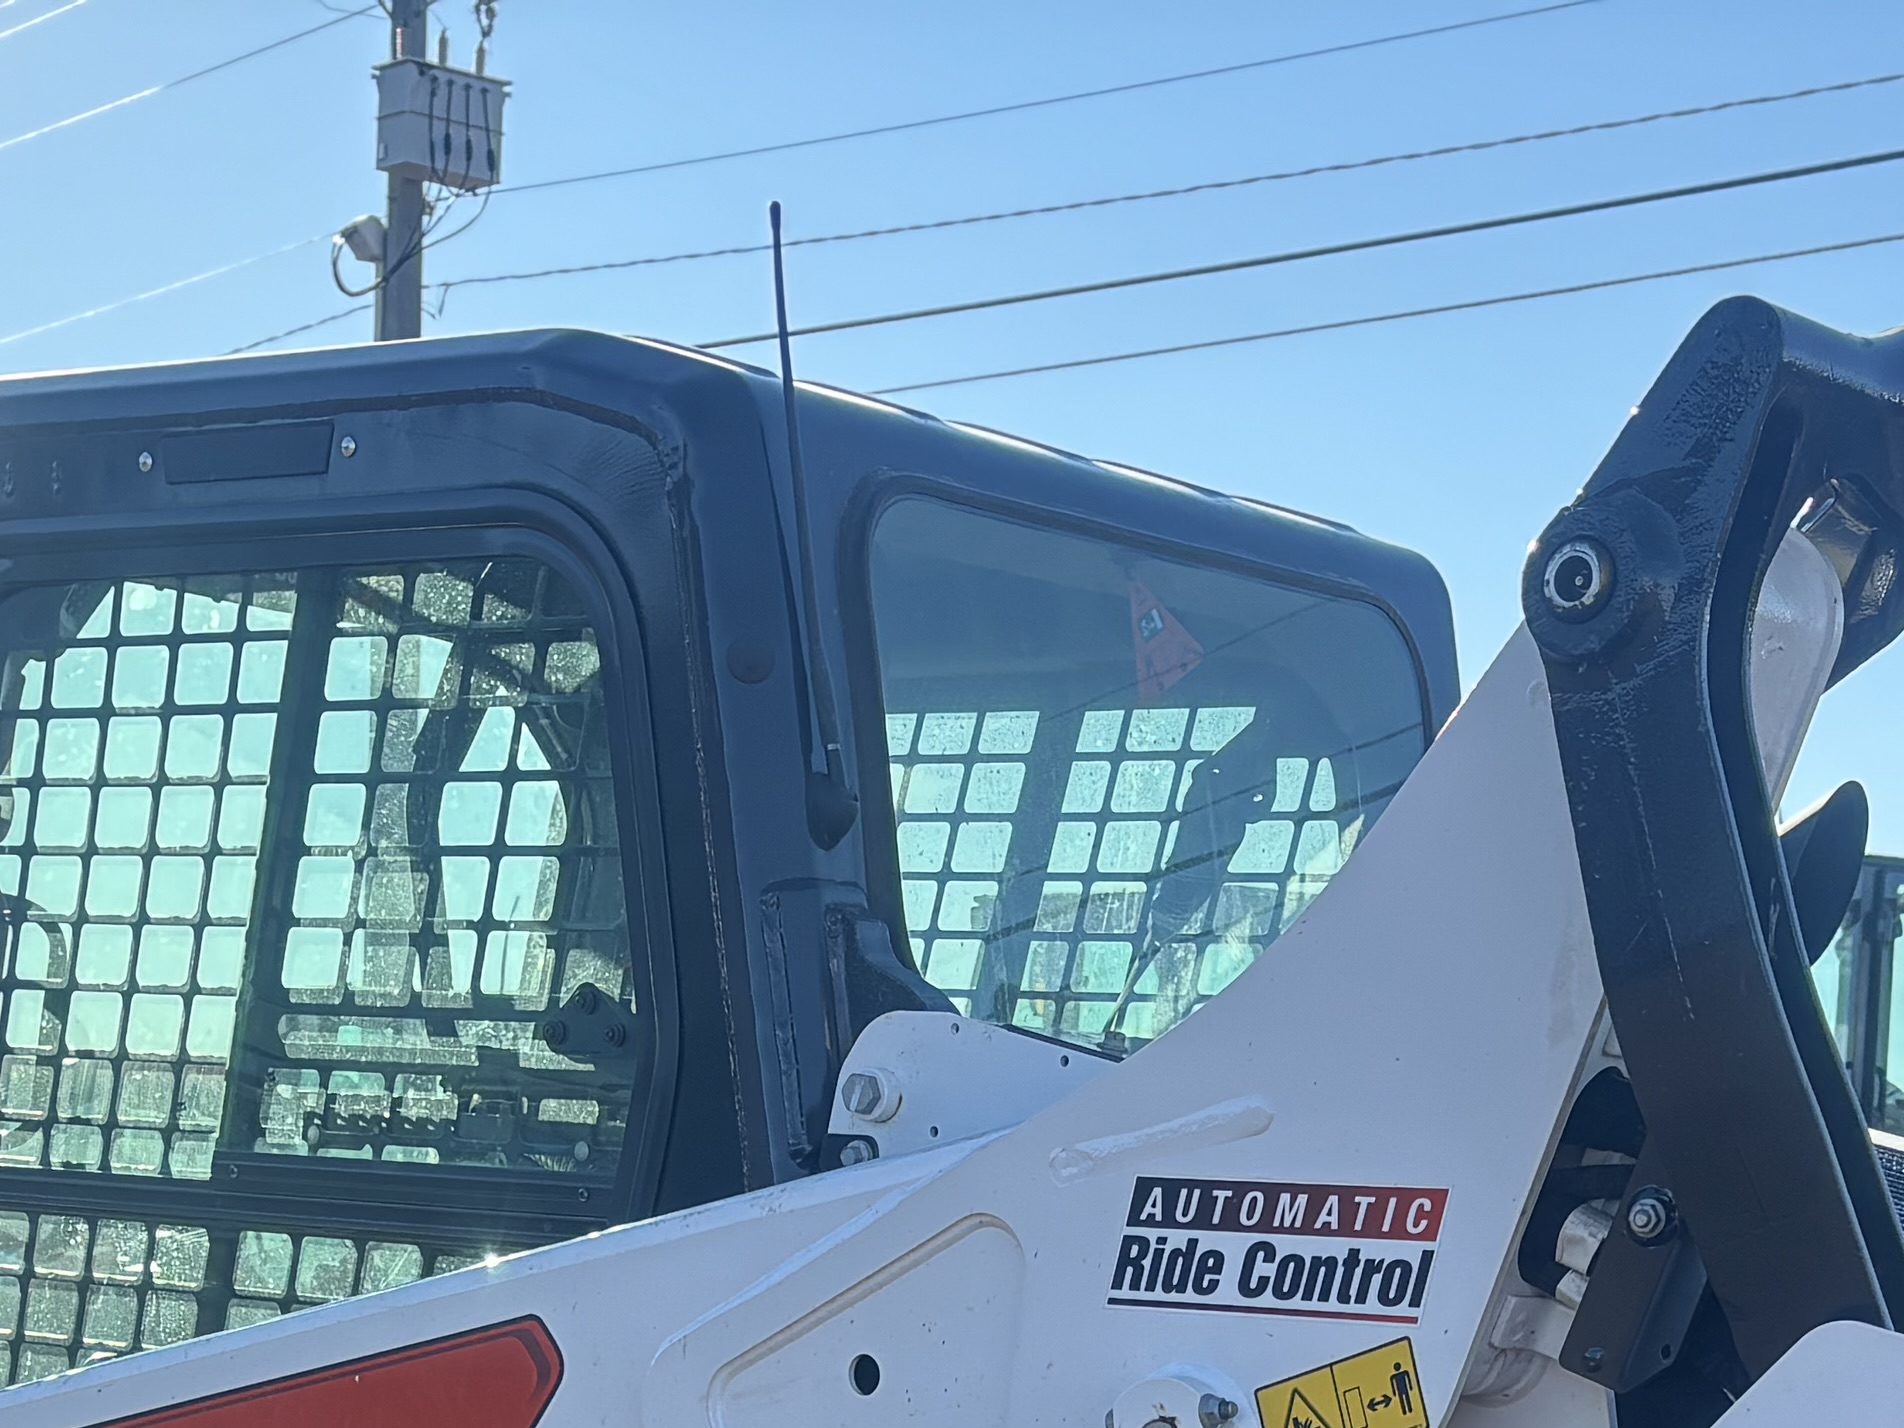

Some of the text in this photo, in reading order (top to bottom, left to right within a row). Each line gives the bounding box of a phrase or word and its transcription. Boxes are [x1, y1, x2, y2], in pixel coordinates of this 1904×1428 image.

[1140, 1187, 1432, 1234] AUTOMATIC
[1110, 1234, 1436, 1309] Ride Control
